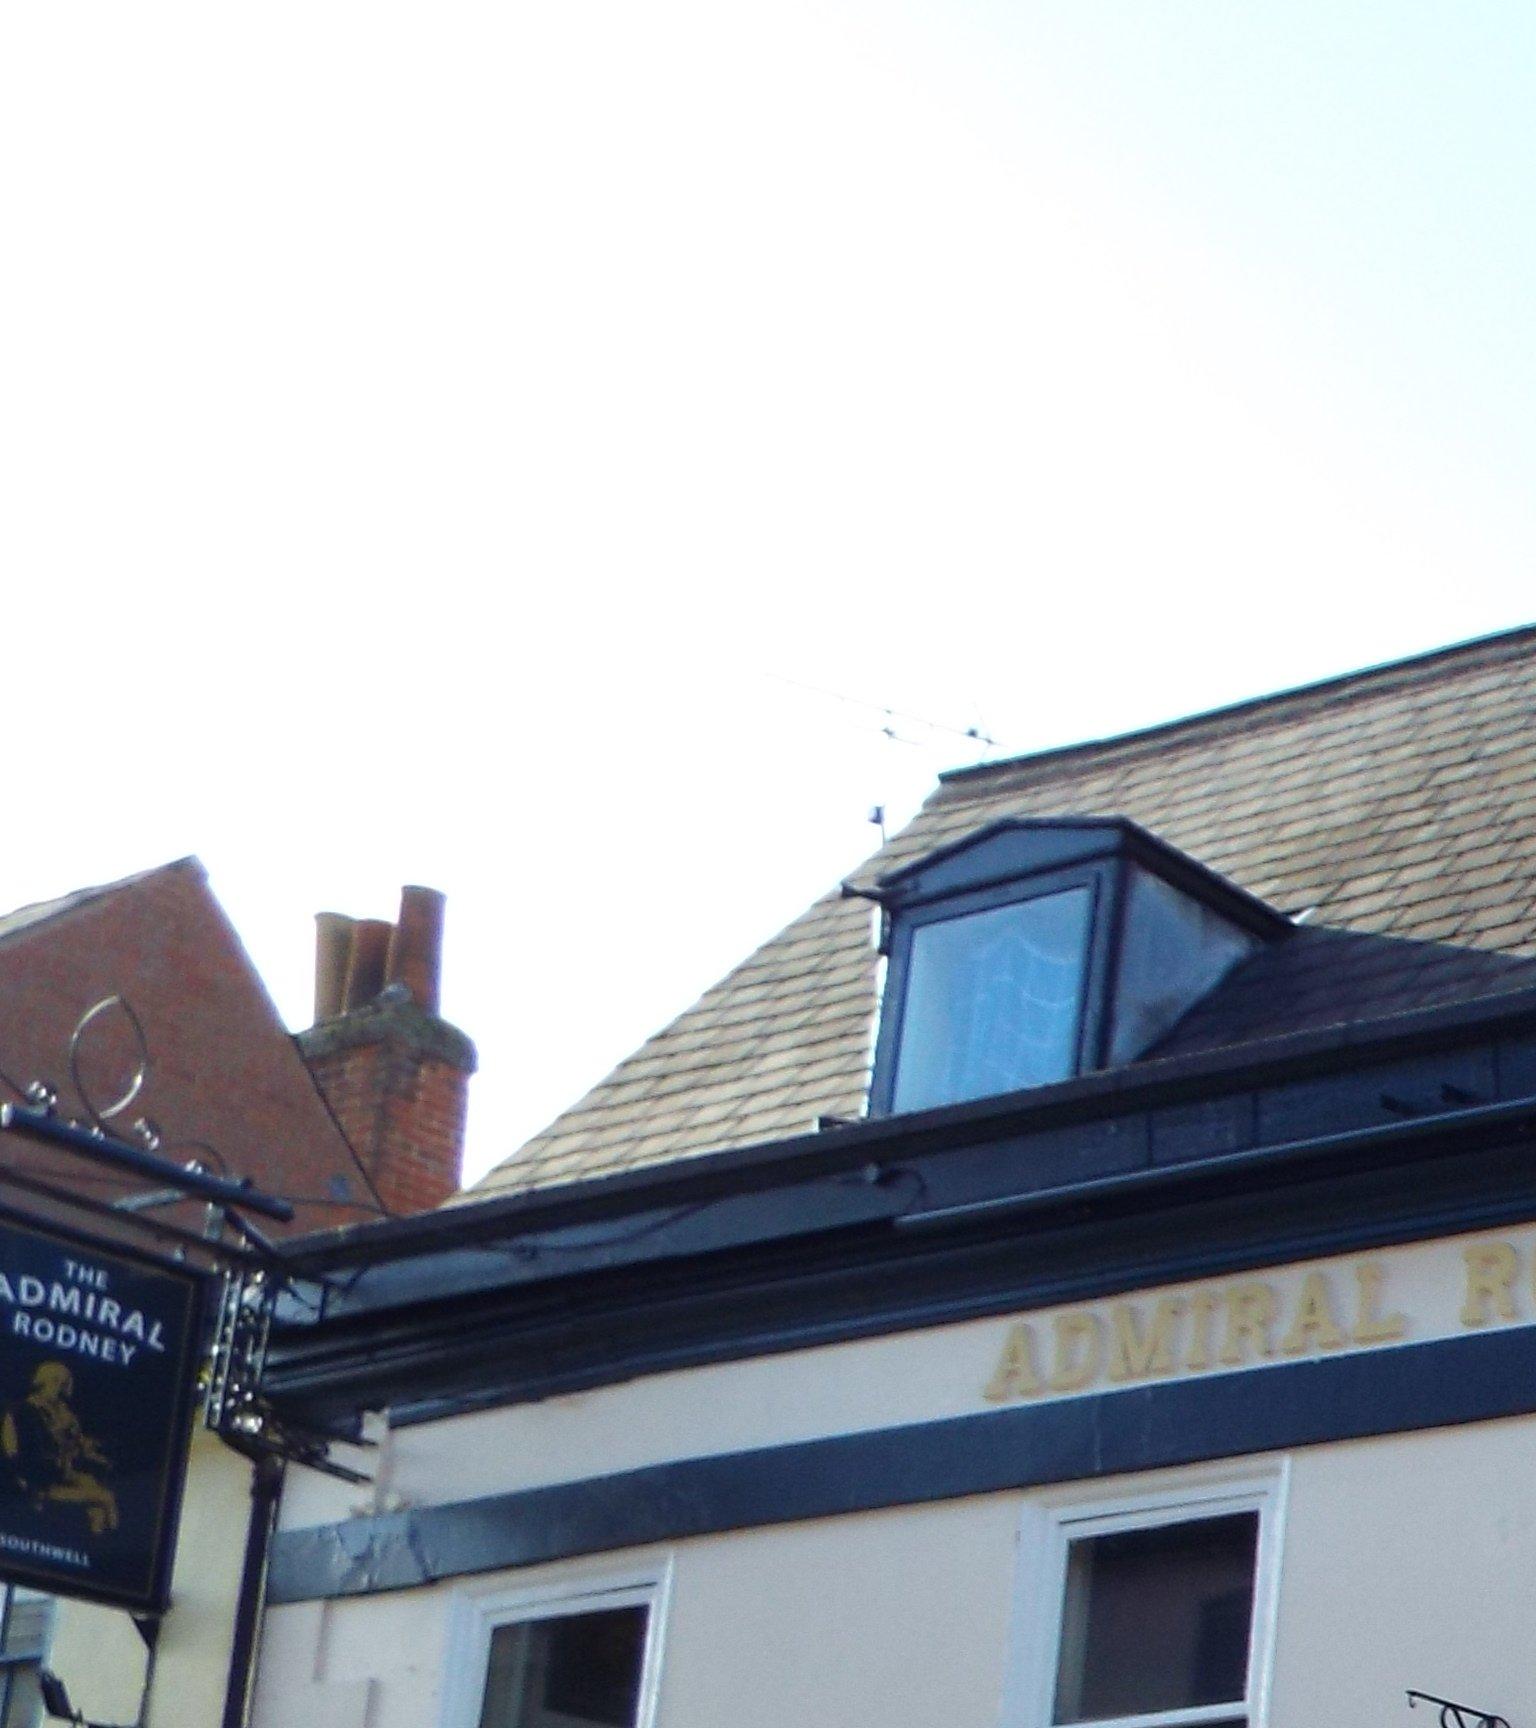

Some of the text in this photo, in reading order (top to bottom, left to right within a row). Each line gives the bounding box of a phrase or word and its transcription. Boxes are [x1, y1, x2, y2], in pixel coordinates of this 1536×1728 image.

[64, 1259, 108, 1290] THE
[0, 1273, 165, 1352] ADMIRAL
[14, 1310, 137, 1367] RODNEY
[984, 1264, 1403, 1401] ADMIRAL
[0, 1534, 91, 1568] SOUTHWELL
